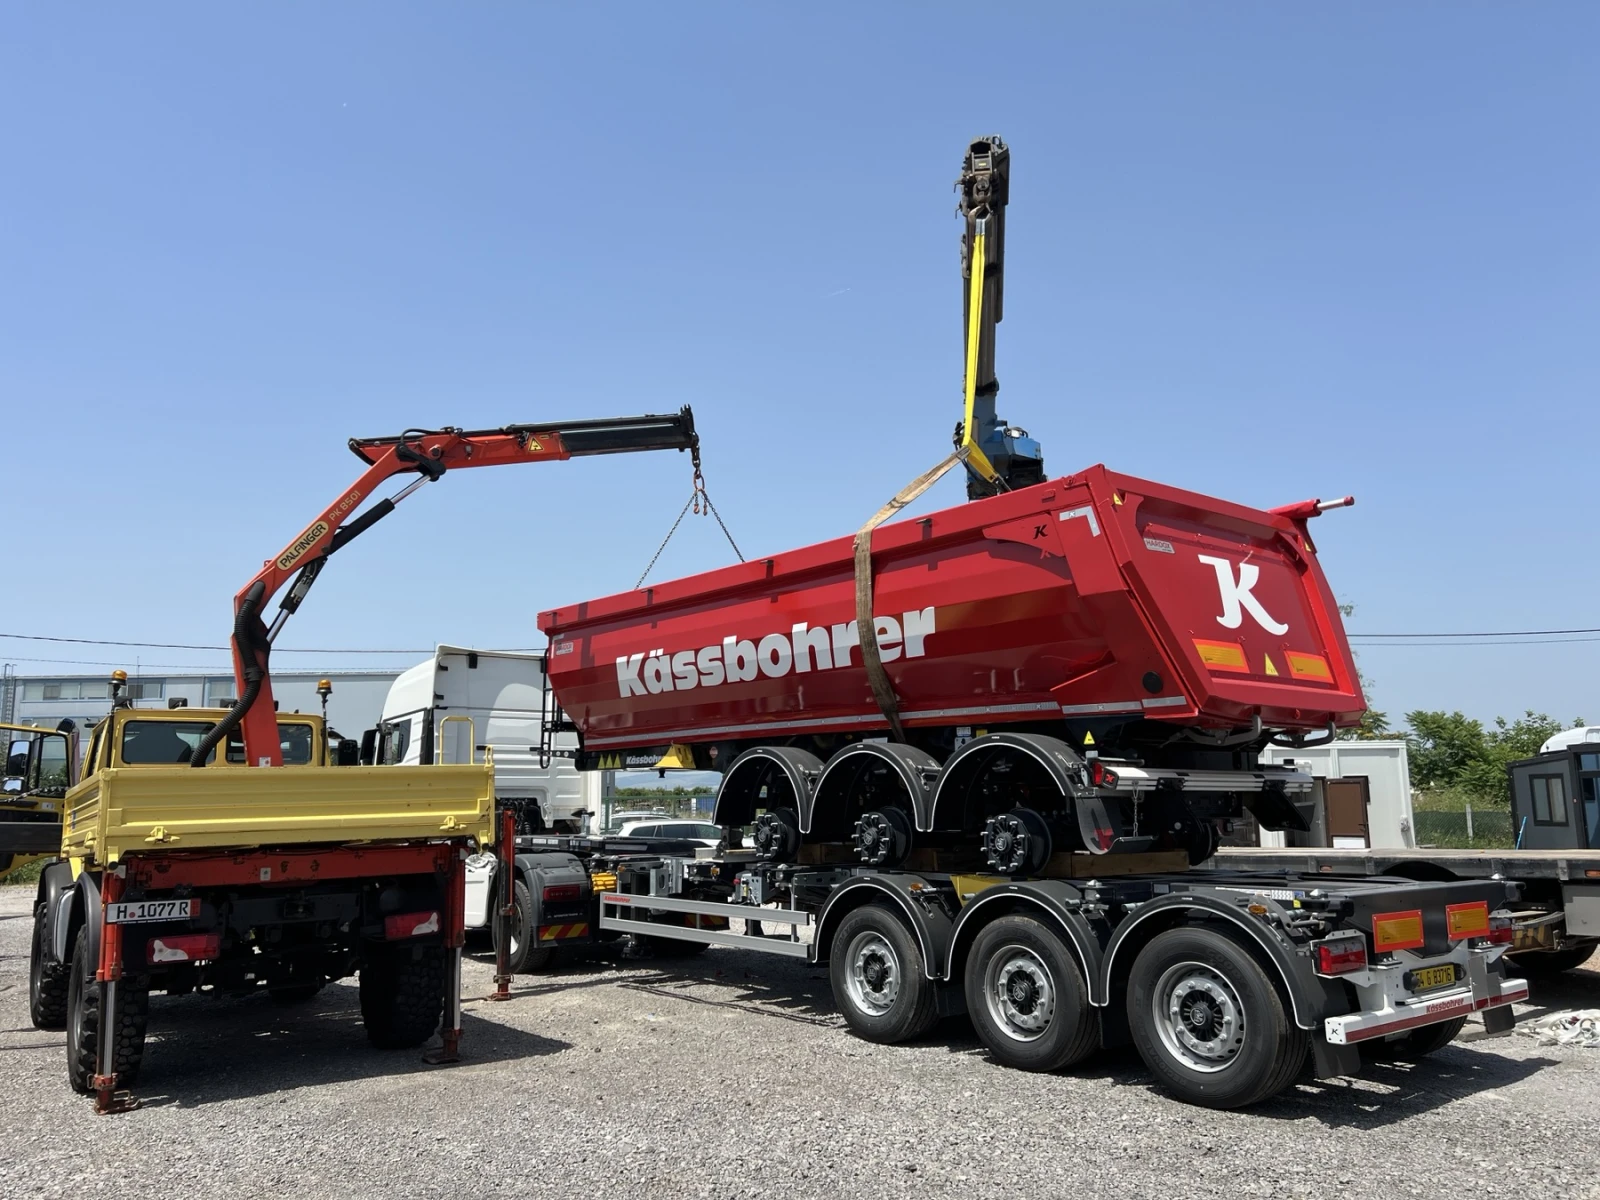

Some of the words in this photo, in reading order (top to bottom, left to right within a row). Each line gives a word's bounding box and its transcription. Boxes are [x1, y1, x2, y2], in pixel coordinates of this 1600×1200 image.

[329, 508, 342, 521] PK
[340, 490, 361, 511] 8501
[1033, 525, 1048, 539] K
[280, 524, 326, 567] PALFINGER
[1198, 554, 1289, 636] K
[616, 606, 936, 698] Kässbohrer
[626, 755, 662, 765] Kässbohr
[117, 905, 127, 919] H
[138, 902, 176, 918] 1077
[179, 902, 189, 915] R
[1433, 967, 1452, 985] 83716
